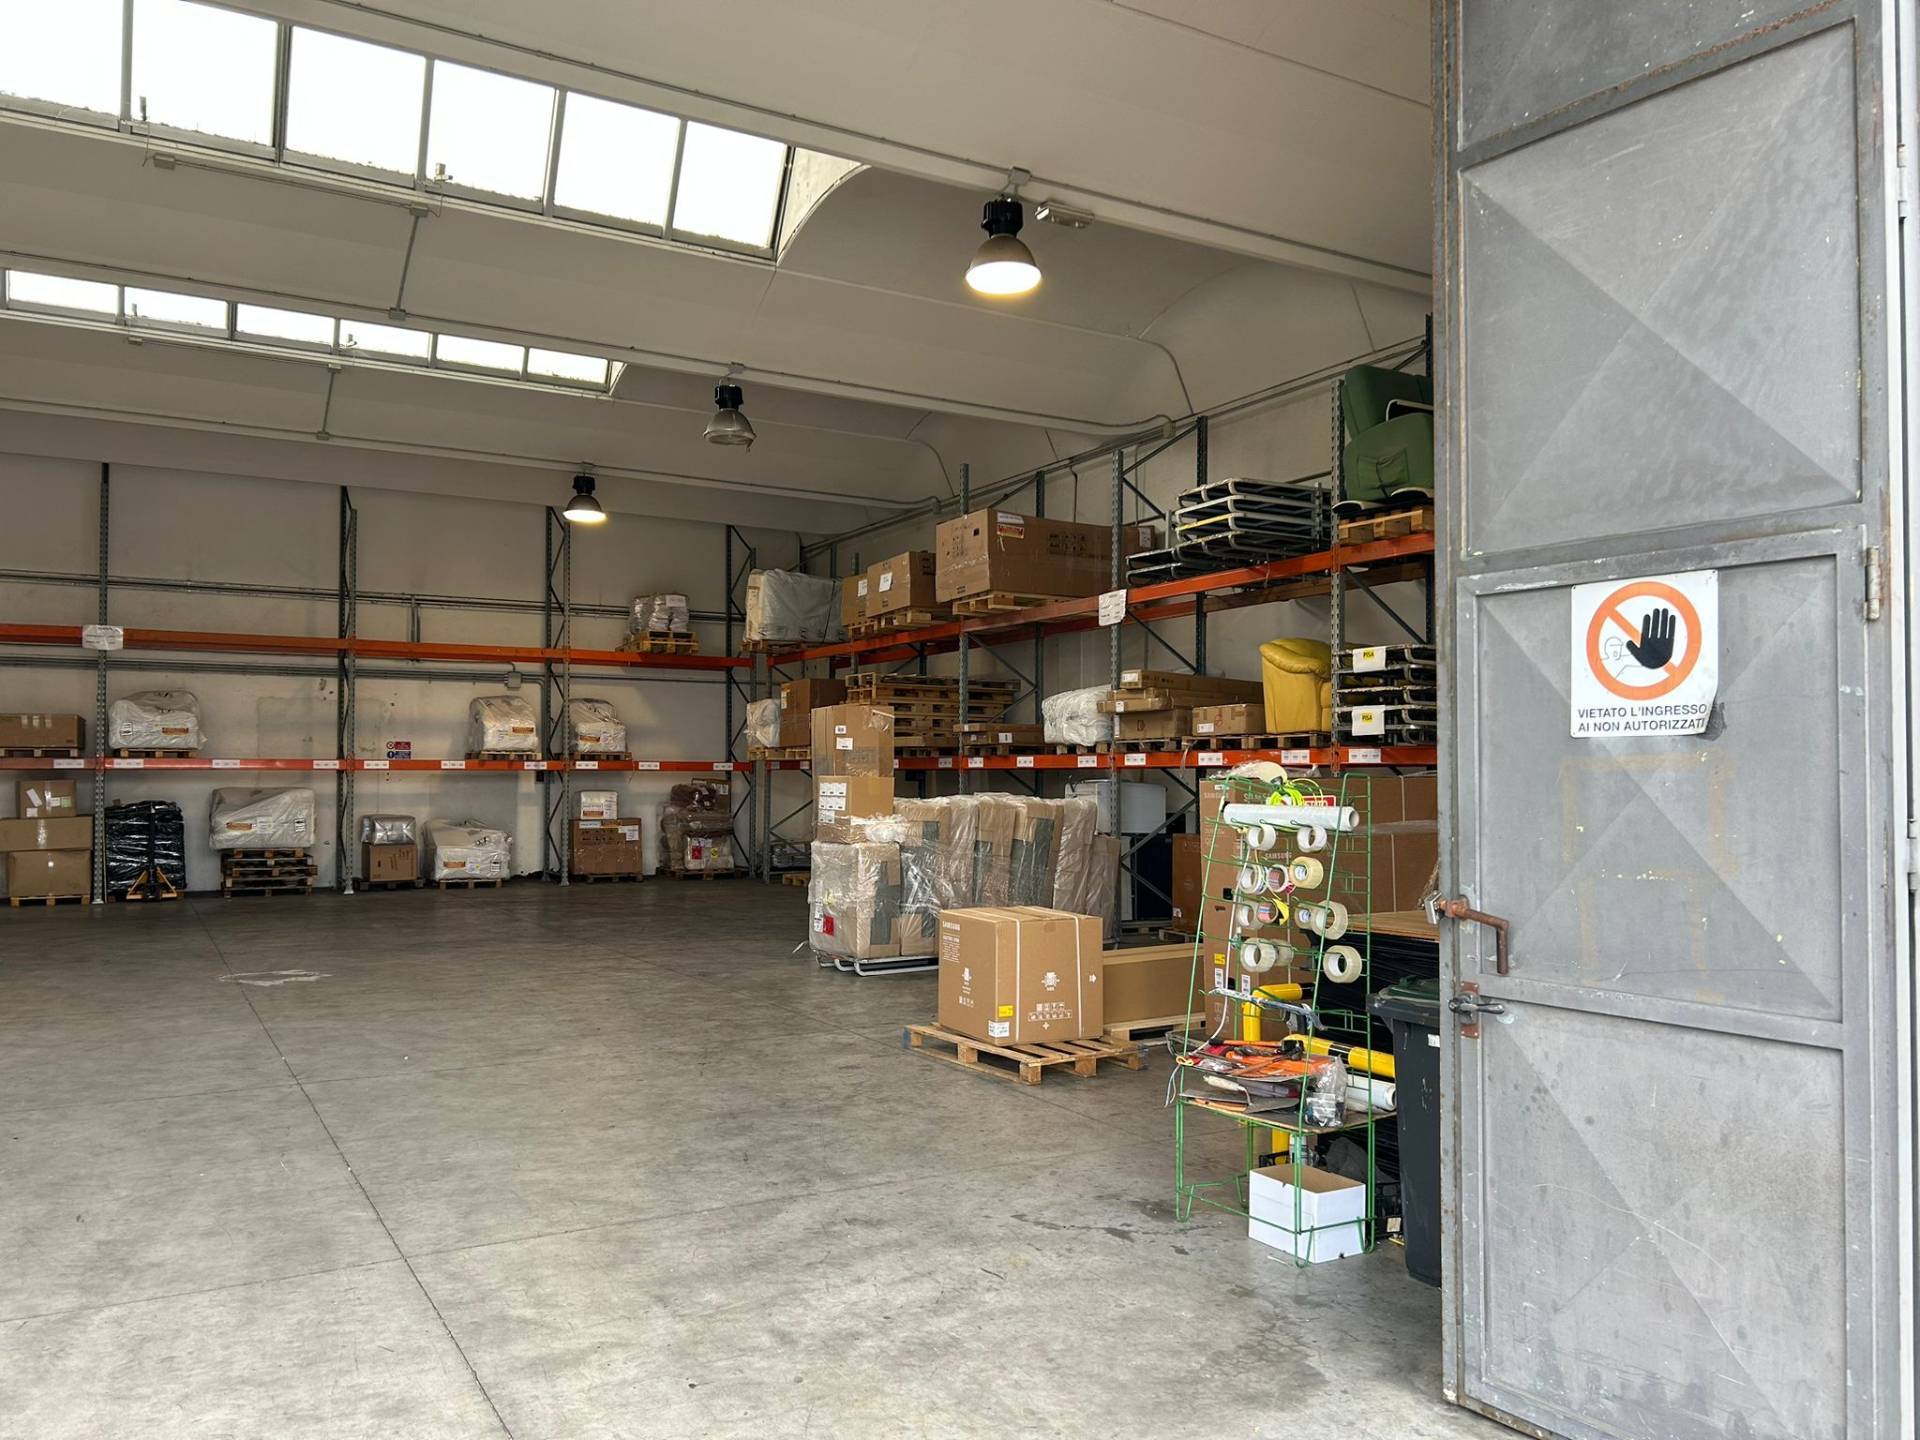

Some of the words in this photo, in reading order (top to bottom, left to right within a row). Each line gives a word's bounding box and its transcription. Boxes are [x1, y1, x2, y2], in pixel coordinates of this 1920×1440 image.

[1577, 707, 1627, 718] VIETATO
[1631, 703, 1708, 717] L'INGRESSO
[1578, 723, 1590, 732] AI
[1593, 721, 1620, 732] NON
[1623, 717, 1705, 731] AUTORIZZATI
